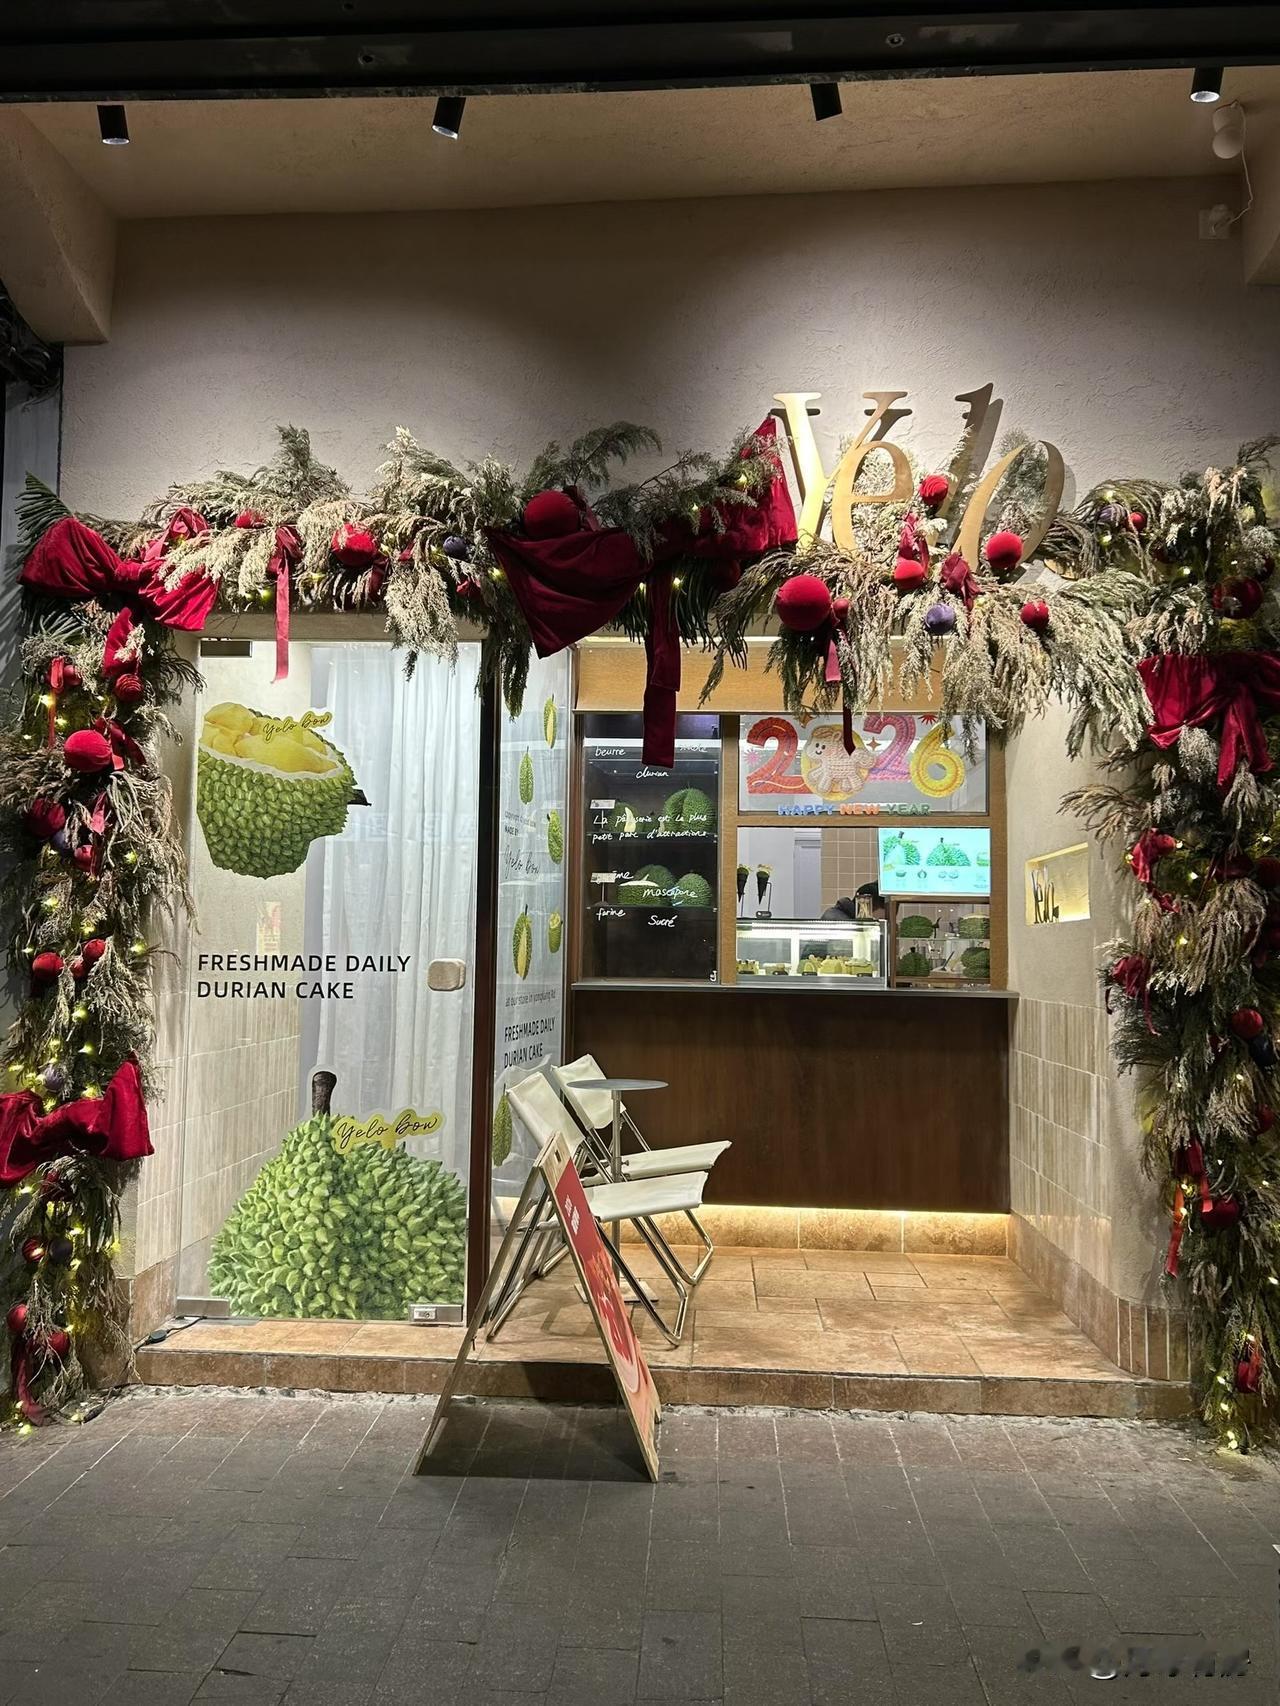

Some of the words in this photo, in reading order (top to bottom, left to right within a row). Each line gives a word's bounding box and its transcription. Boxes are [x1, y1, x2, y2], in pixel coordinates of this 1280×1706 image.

[773, 383, 1064, 573] Yelo
[777, 803, 835, 816] HAPPY
[839, 802, 881, 815] NEW
[887, 803, 932, 816] YEAR
[198, 954, 336, 972] FRESHMADE
[346, 955, 411, 972] DAILY
[197, 981, 286, 998] DURIAN
[295, 982, 354, 998] CAKE
[505, 1020, 539, 1042] FRESHMADE
[541, 1016, 556, 1034] DAILY
[504, 1047, 528, 1069] DURIAN
[529, 1042, 543, 1060] CAKE
[337, 1119, 388, 1149] Yelo
